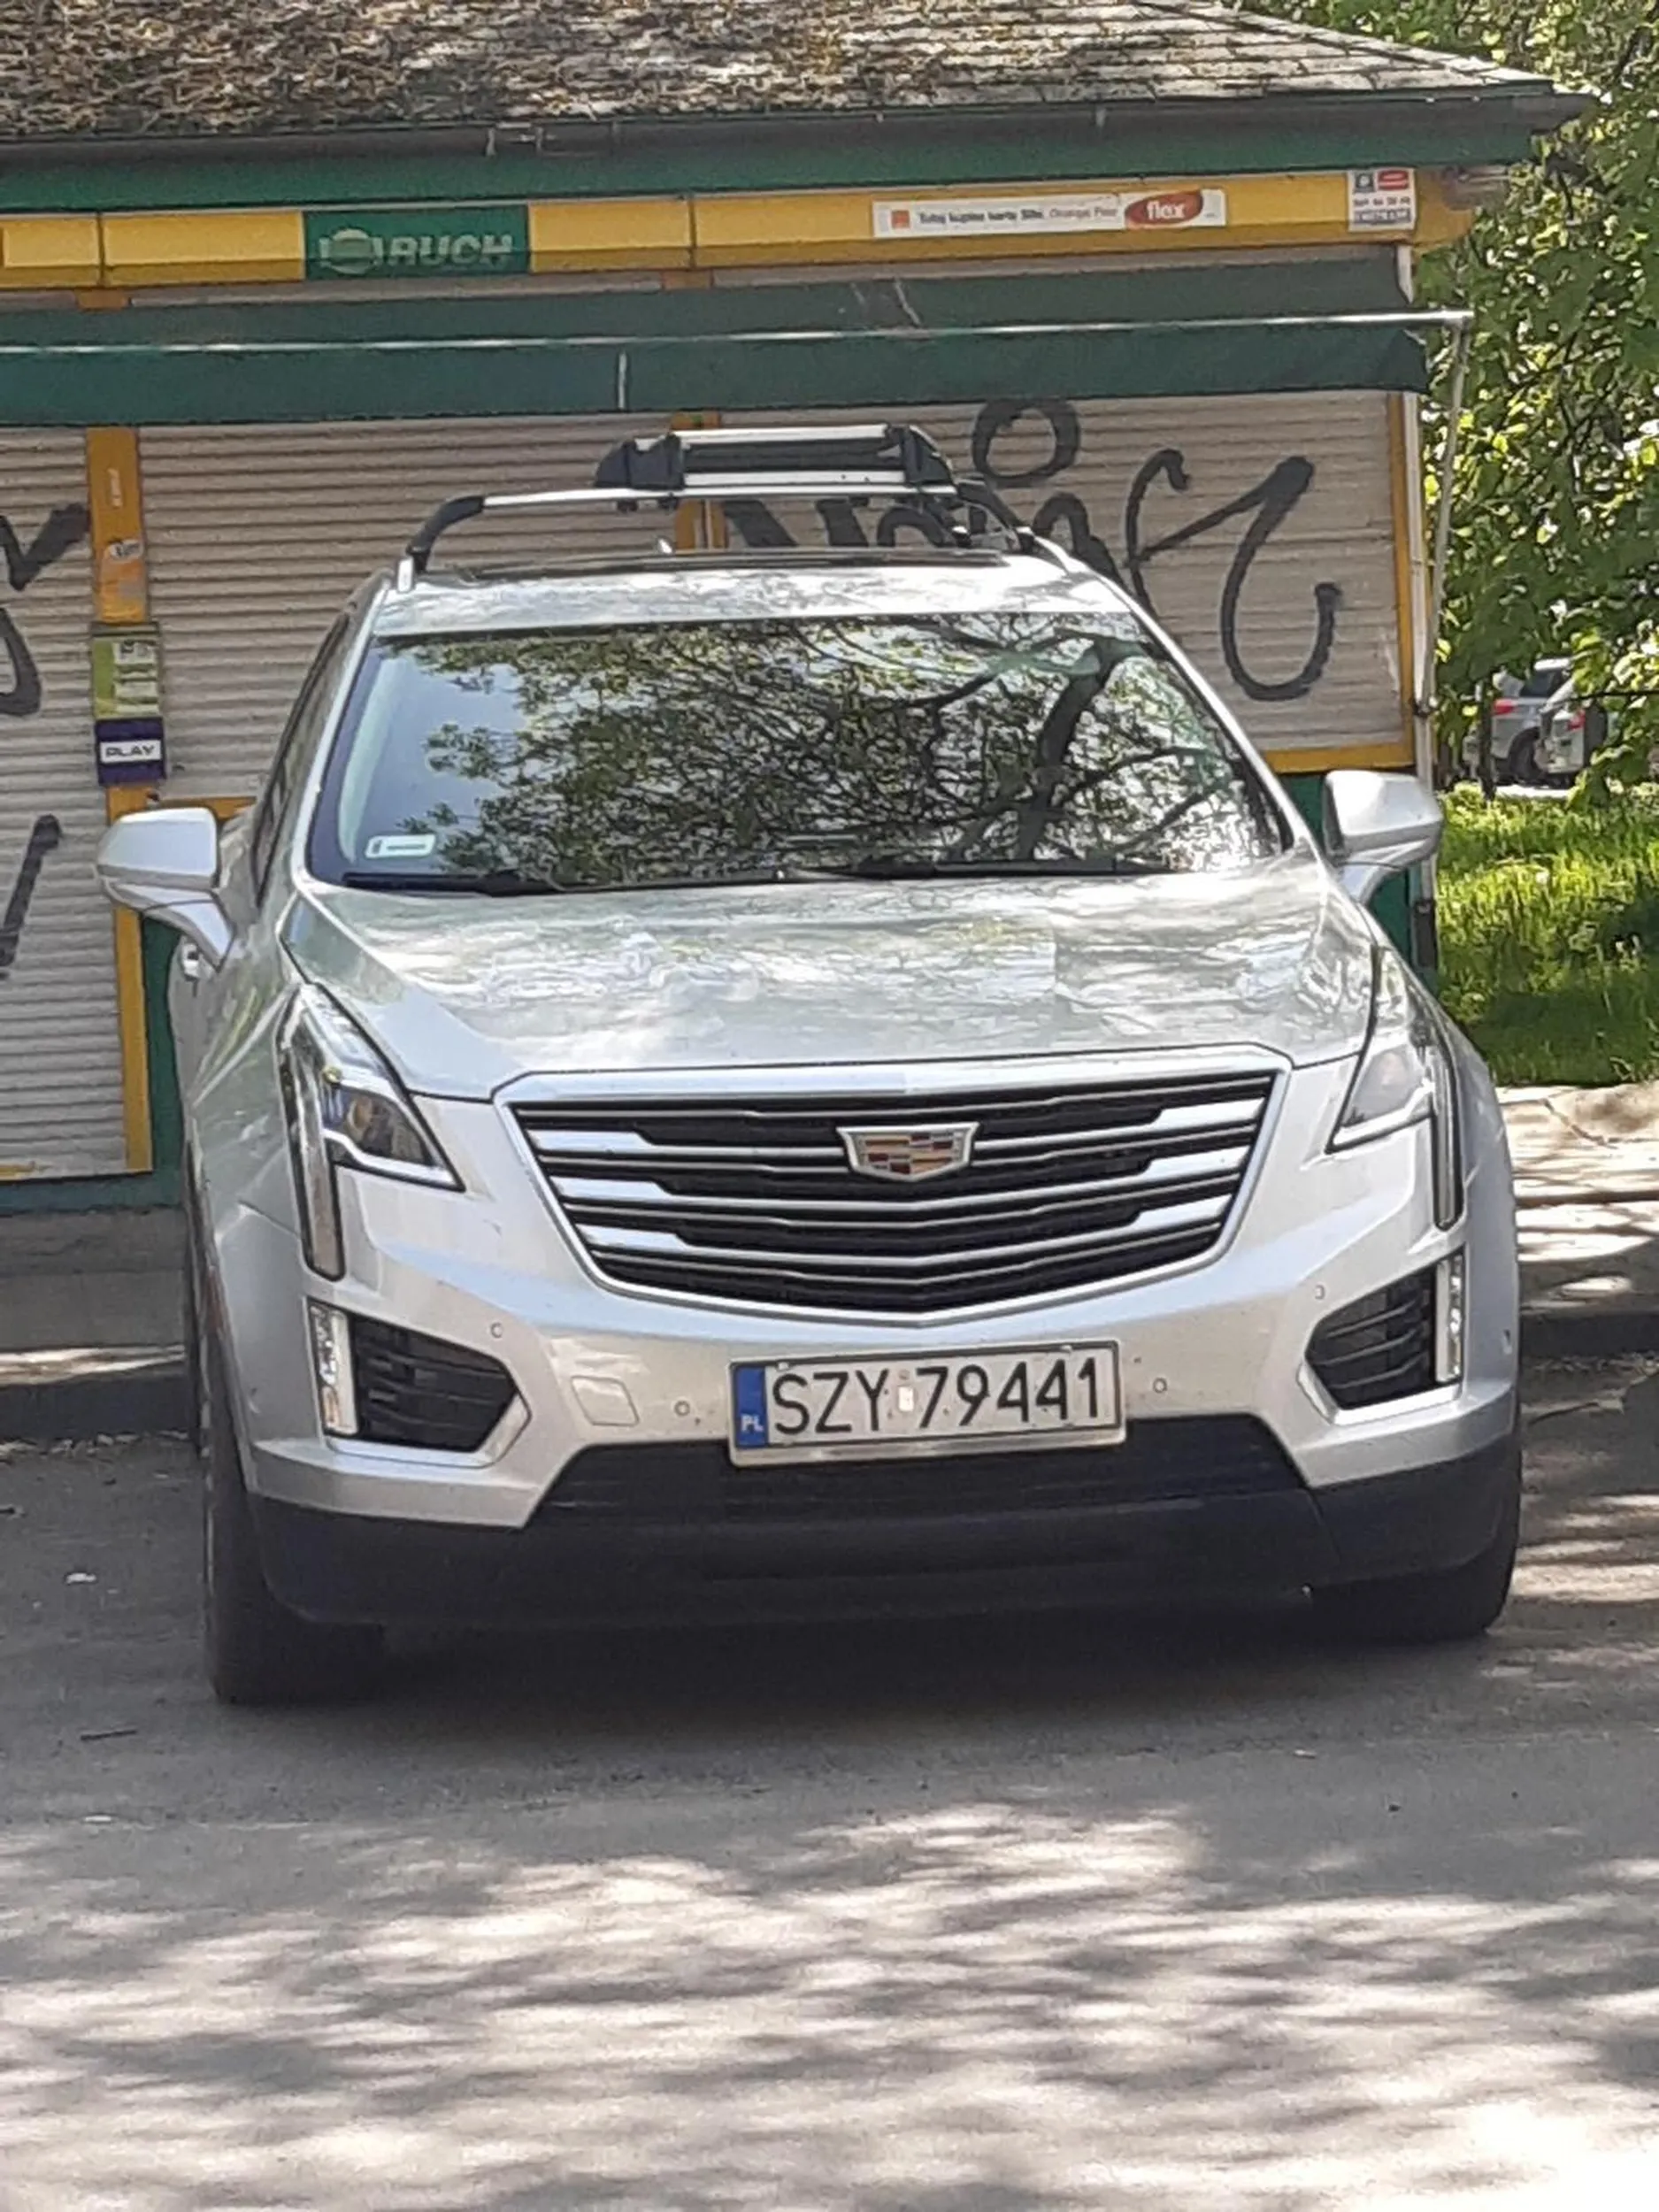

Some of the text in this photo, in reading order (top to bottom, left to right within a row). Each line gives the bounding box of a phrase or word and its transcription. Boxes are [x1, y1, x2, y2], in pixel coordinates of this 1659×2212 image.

[1146, 200, 1187, 221] flex
[388, 234, 513, 267] RUCH
[105, 744, 156, 758] PLAY
[772, 1356, 1100, 1435] SZY 79441
[741, 1414, 764, 1432] PL
